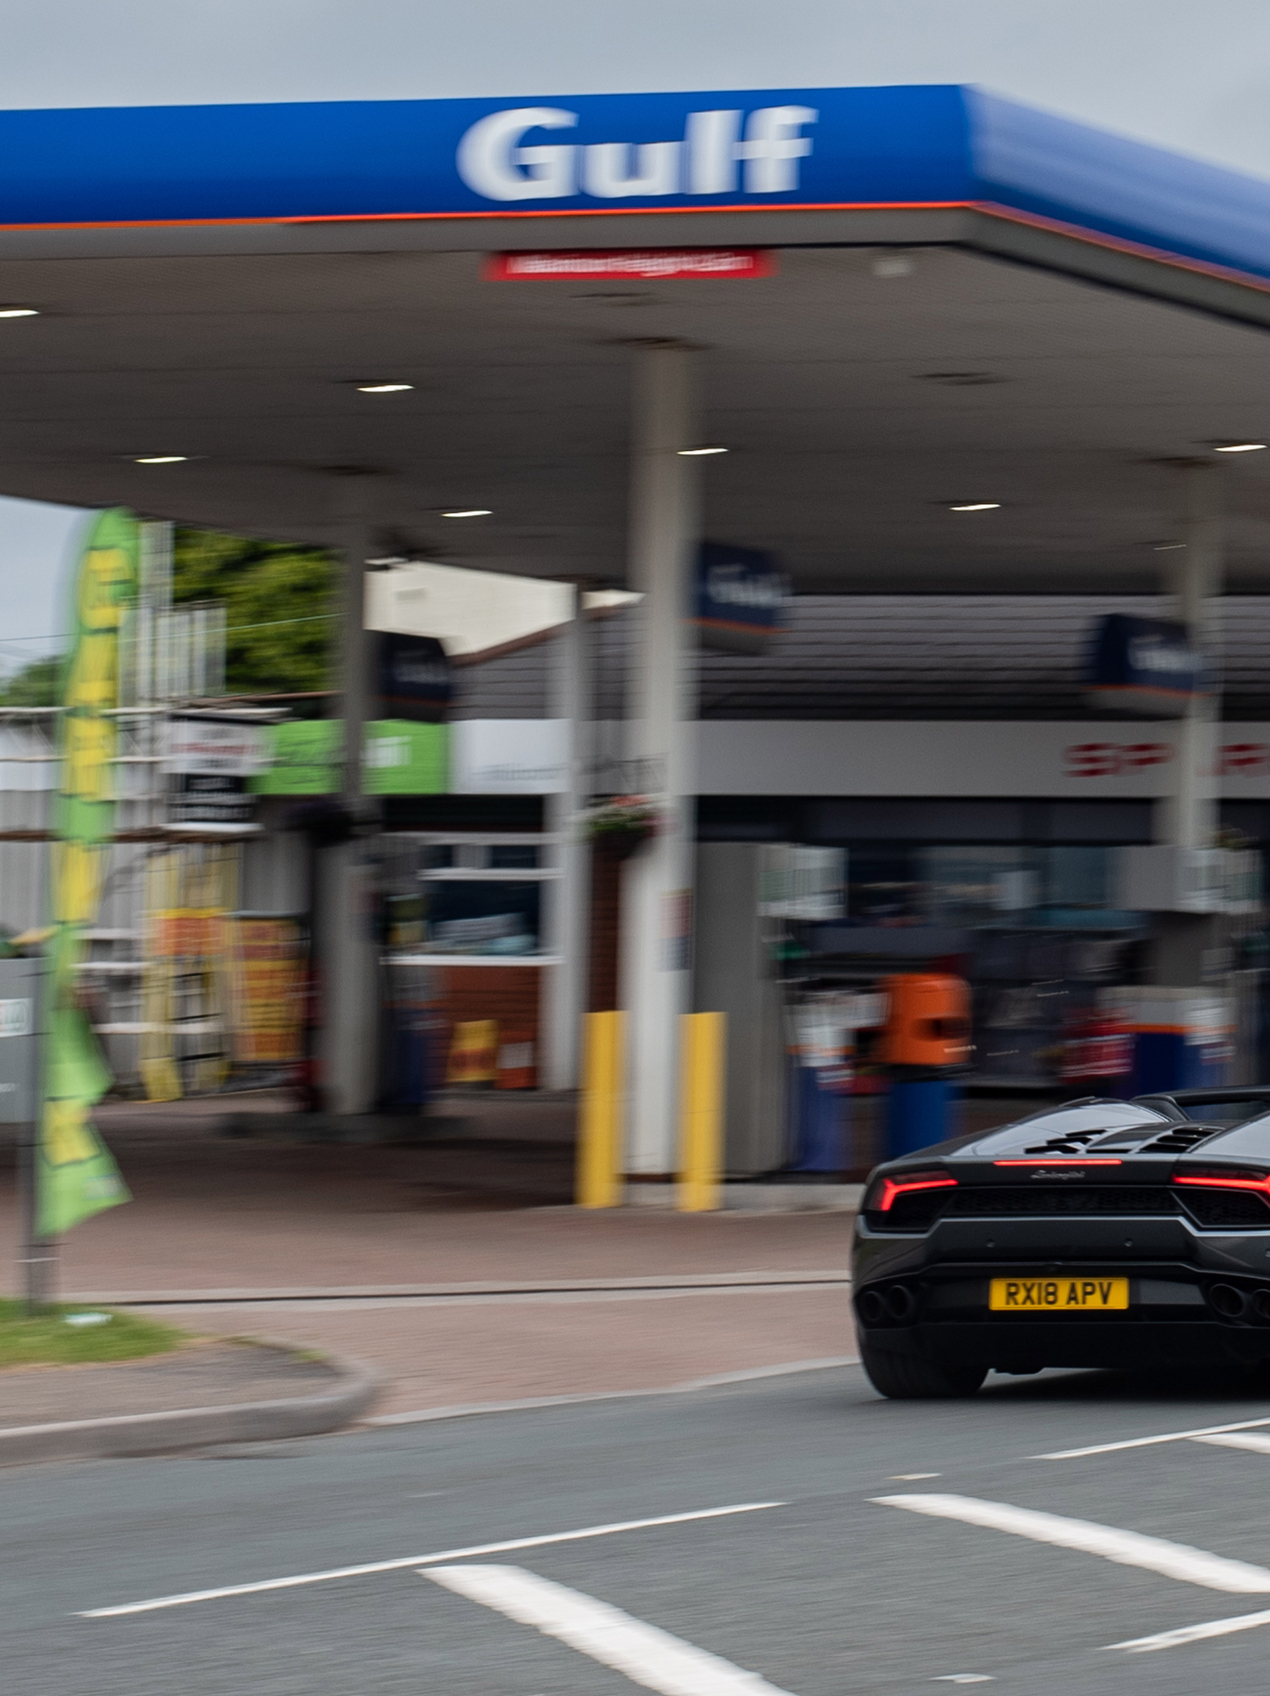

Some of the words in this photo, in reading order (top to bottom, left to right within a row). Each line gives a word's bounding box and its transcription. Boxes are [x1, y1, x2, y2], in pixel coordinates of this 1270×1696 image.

[455, 105, 819, 200] Gulf
[1005, 1282, 1058, 1305] RX18
[1066, 1282, 1113, 1305] APV
